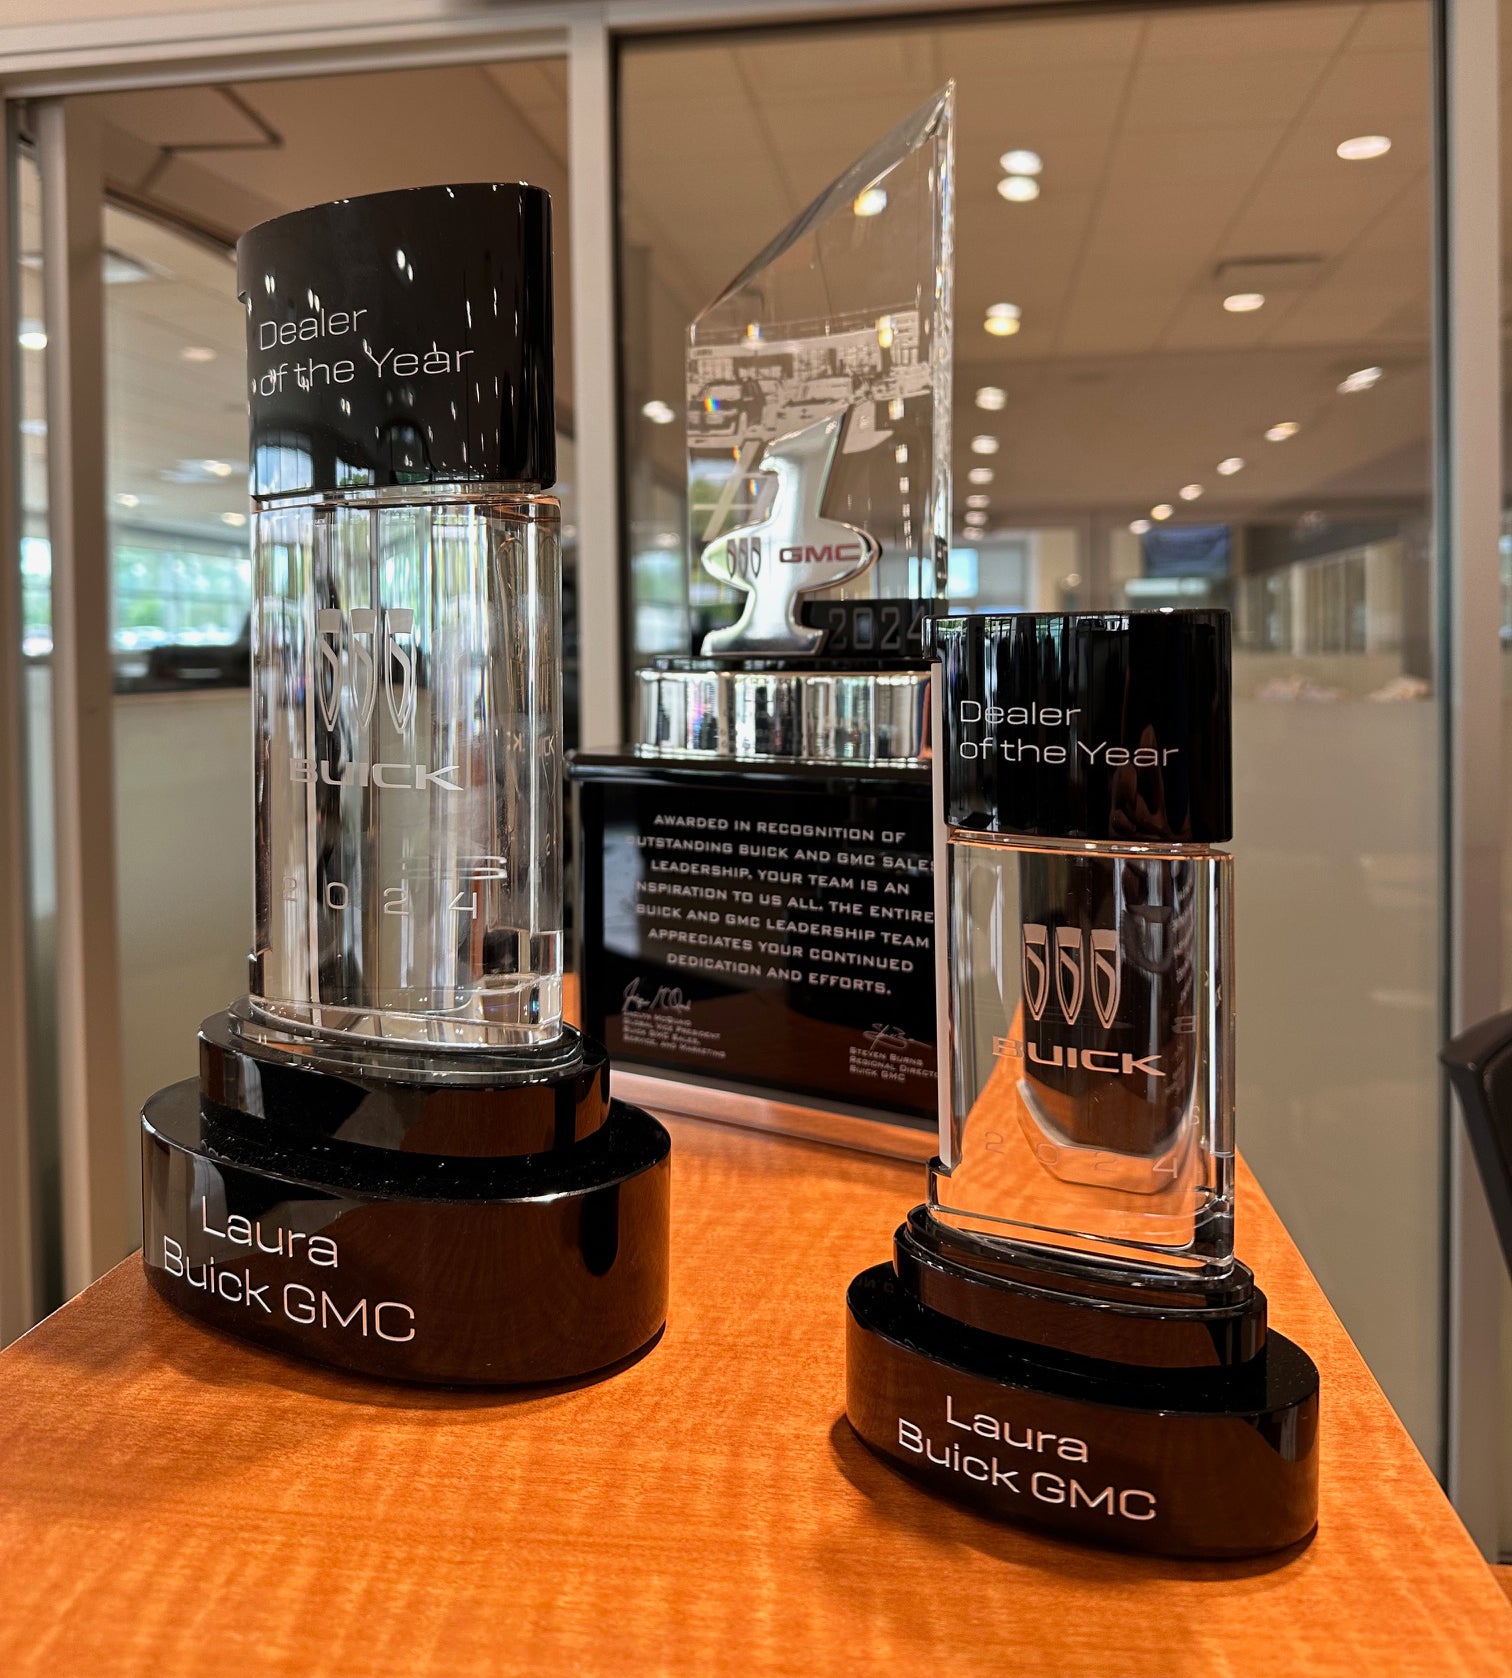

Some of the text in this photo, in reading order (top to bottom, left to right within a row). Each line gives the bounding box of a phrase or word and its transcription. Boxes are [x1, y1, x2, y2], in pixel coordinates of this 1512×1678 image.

[260, 308, 367, 350] Dealer
[260, 348, 475, 396] of the Year
[779, 544, 861, 563] GMC
[828, 605, 922, 649] 2024
[960, 700, 1081, 726] Dealer
[959, 737, 1179, 767] of the Year
[289, 758, 464, 791] BUICK
[653, 814, 906, 843] AWARDED IN RECOGNITION OF
[651, 859, 910, 895] LEADERSHIP. YOUR TEAM IS AN
[738, 844, 789, 859] BUICK
[793, 848, 831, 863] AND
[837, 852, 875, 867] GMC
[882, 856, 934, 872] SALE
[635, 880, 934, 923] NSPIRATION TO US ALL. THE ENTIRE
[636, 903, 930, 949] BUICK AND GMC LEADERSHIP TEAM
[648, 927, 914, 973] APPRECIATES YOUR CONTINUED
[667, 952, 892, 996] DEDICATION AND EFFORTS.
[849, 1055, 938, 1078] REGIONAL DIRECTO
[881, 1070, 906, 1083] GMC
[992, 1036, 1166, 1077] BUICK
[202, 1195, 338, 1268] Laura
[163, 1235, 415, 1342] Buick GMC
[946, 1395, 1088, 1463] Laura
[899, 1417, 1157, 1521] Buick GMC
